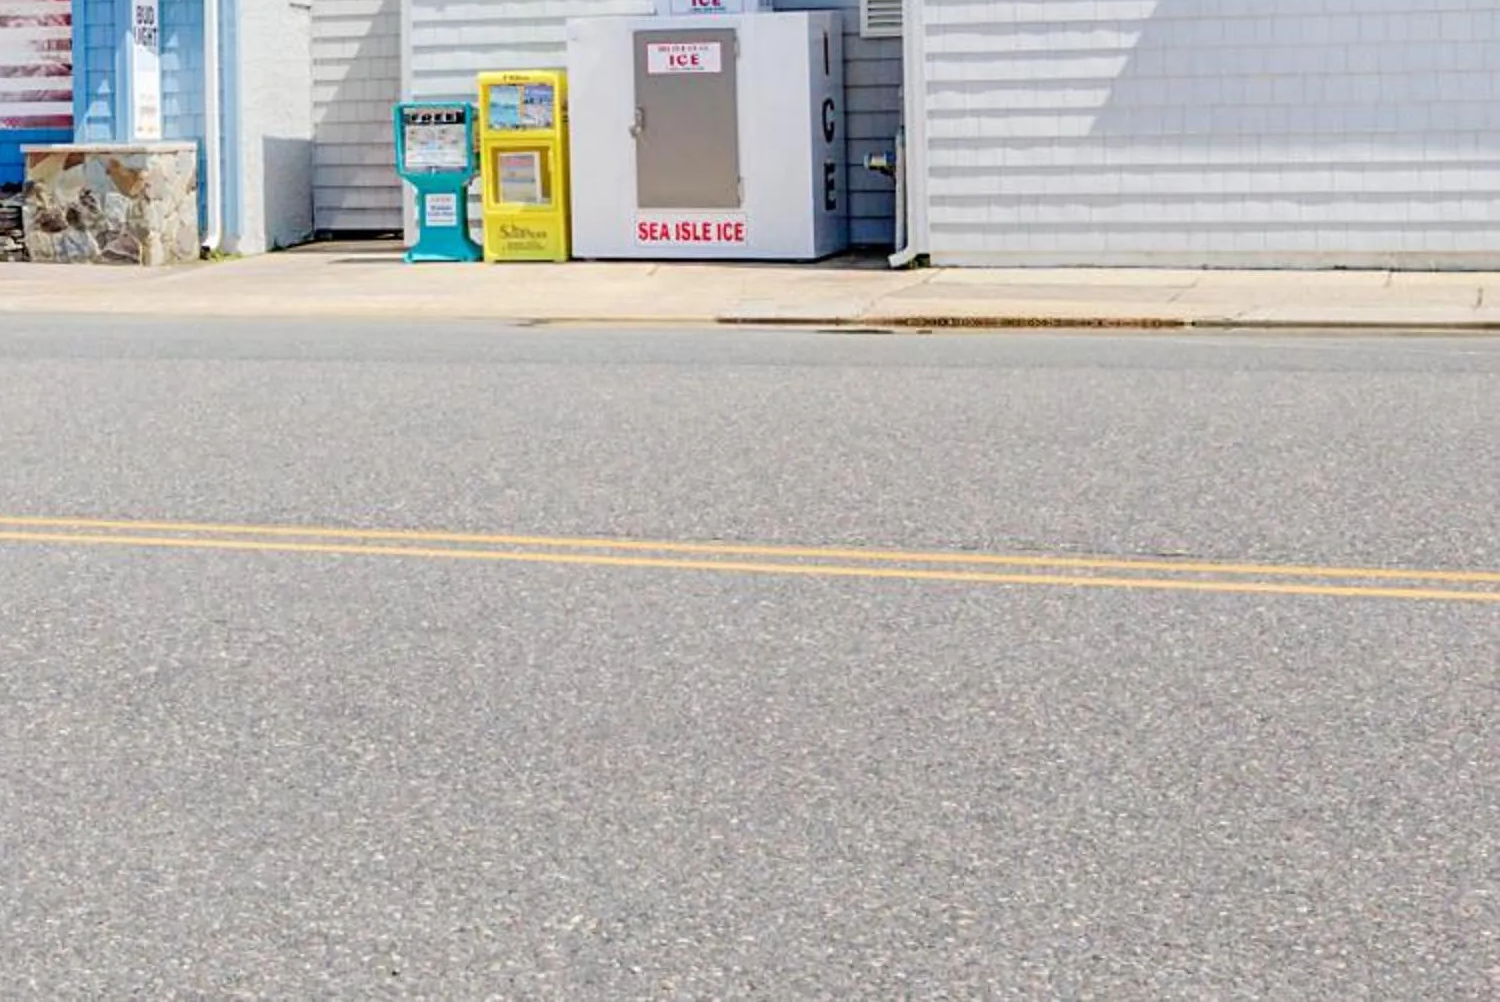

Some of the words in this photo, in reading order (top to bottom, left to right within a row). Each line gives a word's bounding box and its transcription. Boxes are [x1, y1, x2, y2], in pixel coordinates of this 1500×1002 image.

[136, 6, 154, 24] BUD
[133, 28, 158, 46] LIGHT
[669, 54, 699, 66] ICE
[822, 31, 837, 211] ICE
[637, 221, 671, 241] SEA
[675, 221, 712, 241] ISLE
[716, 221, 745, 241] ICE
